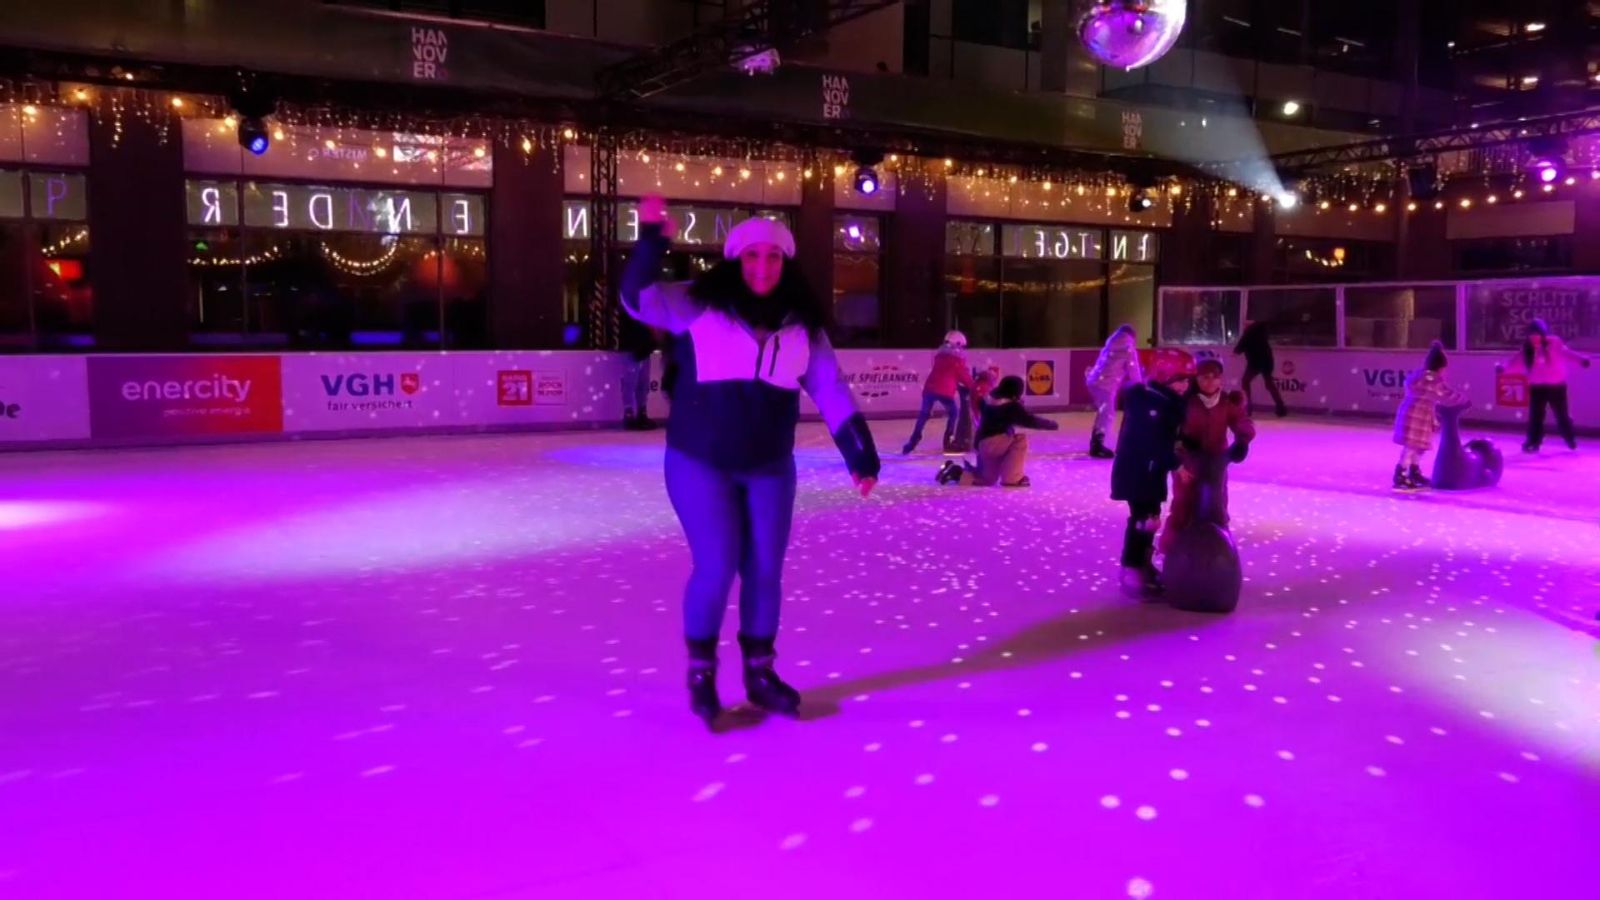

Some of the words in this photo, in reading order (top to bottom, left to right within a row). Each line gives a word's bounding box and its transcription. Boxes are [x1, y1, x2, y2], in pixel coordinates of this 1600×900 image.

[413, 62, 435, 79] ER
[823, 104, 841, 118] ER
[1501, 290, 1578, 306] SCHLITT
[122, 373, 251, 402] enercity
[320, 373, 394, 396] VGH
[328, 401, 348, 411] fair
